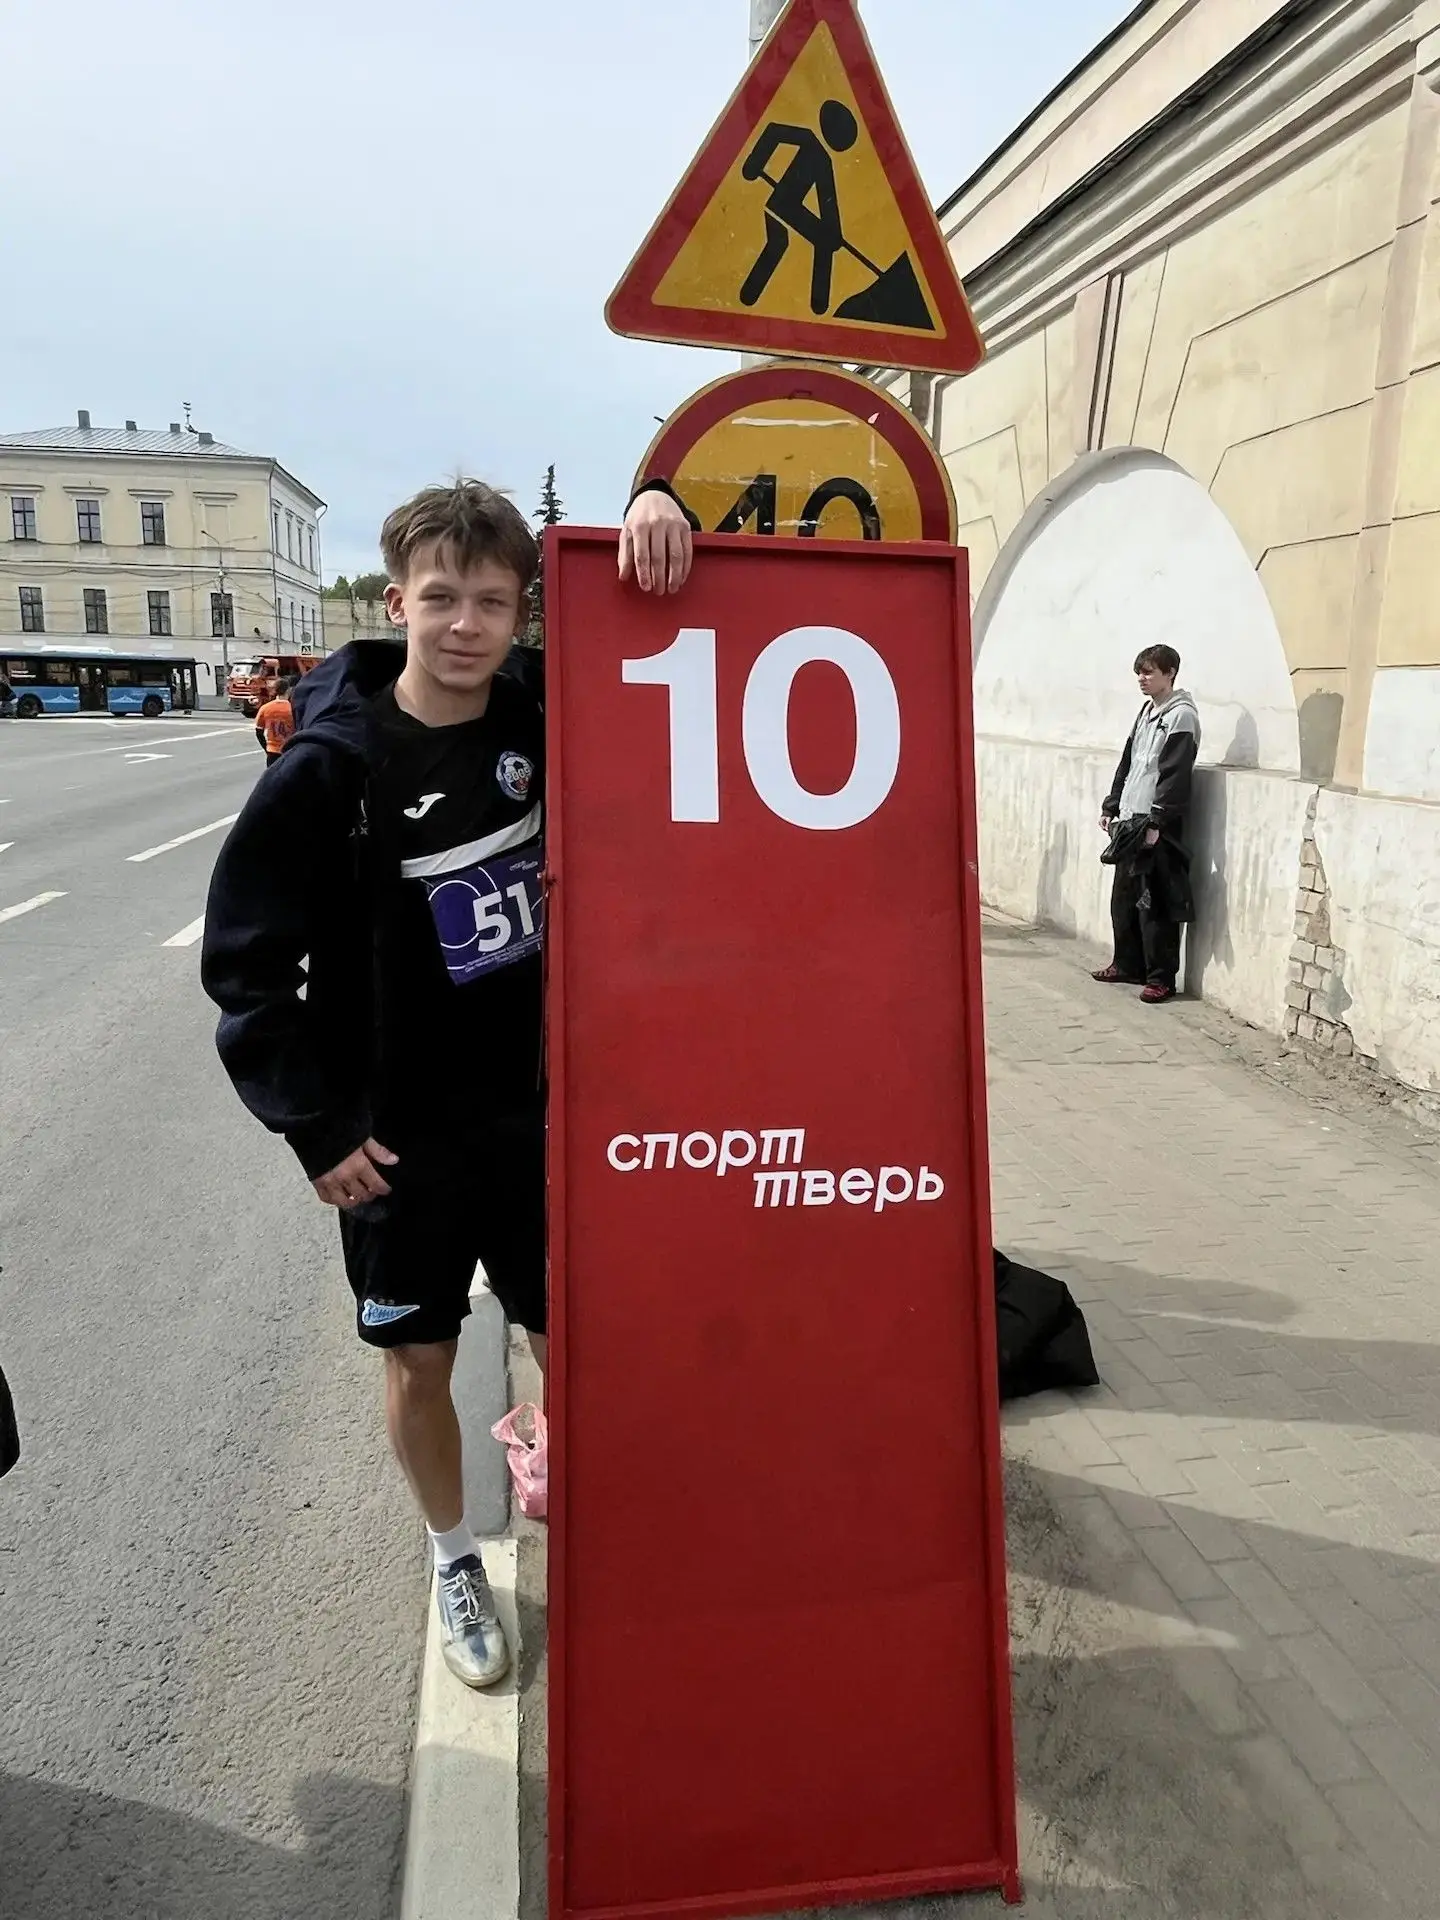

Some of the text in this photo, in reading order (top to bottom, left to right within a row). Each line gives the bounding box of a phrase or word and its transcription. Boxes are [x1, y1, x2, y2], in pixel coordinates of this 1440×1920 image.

[621, 626, 901, 831] 10
[473, 881, 534, 952] 51
[607, 1128, 805, 1177] спорт
[753, 1165, 946, 1213] тверь
